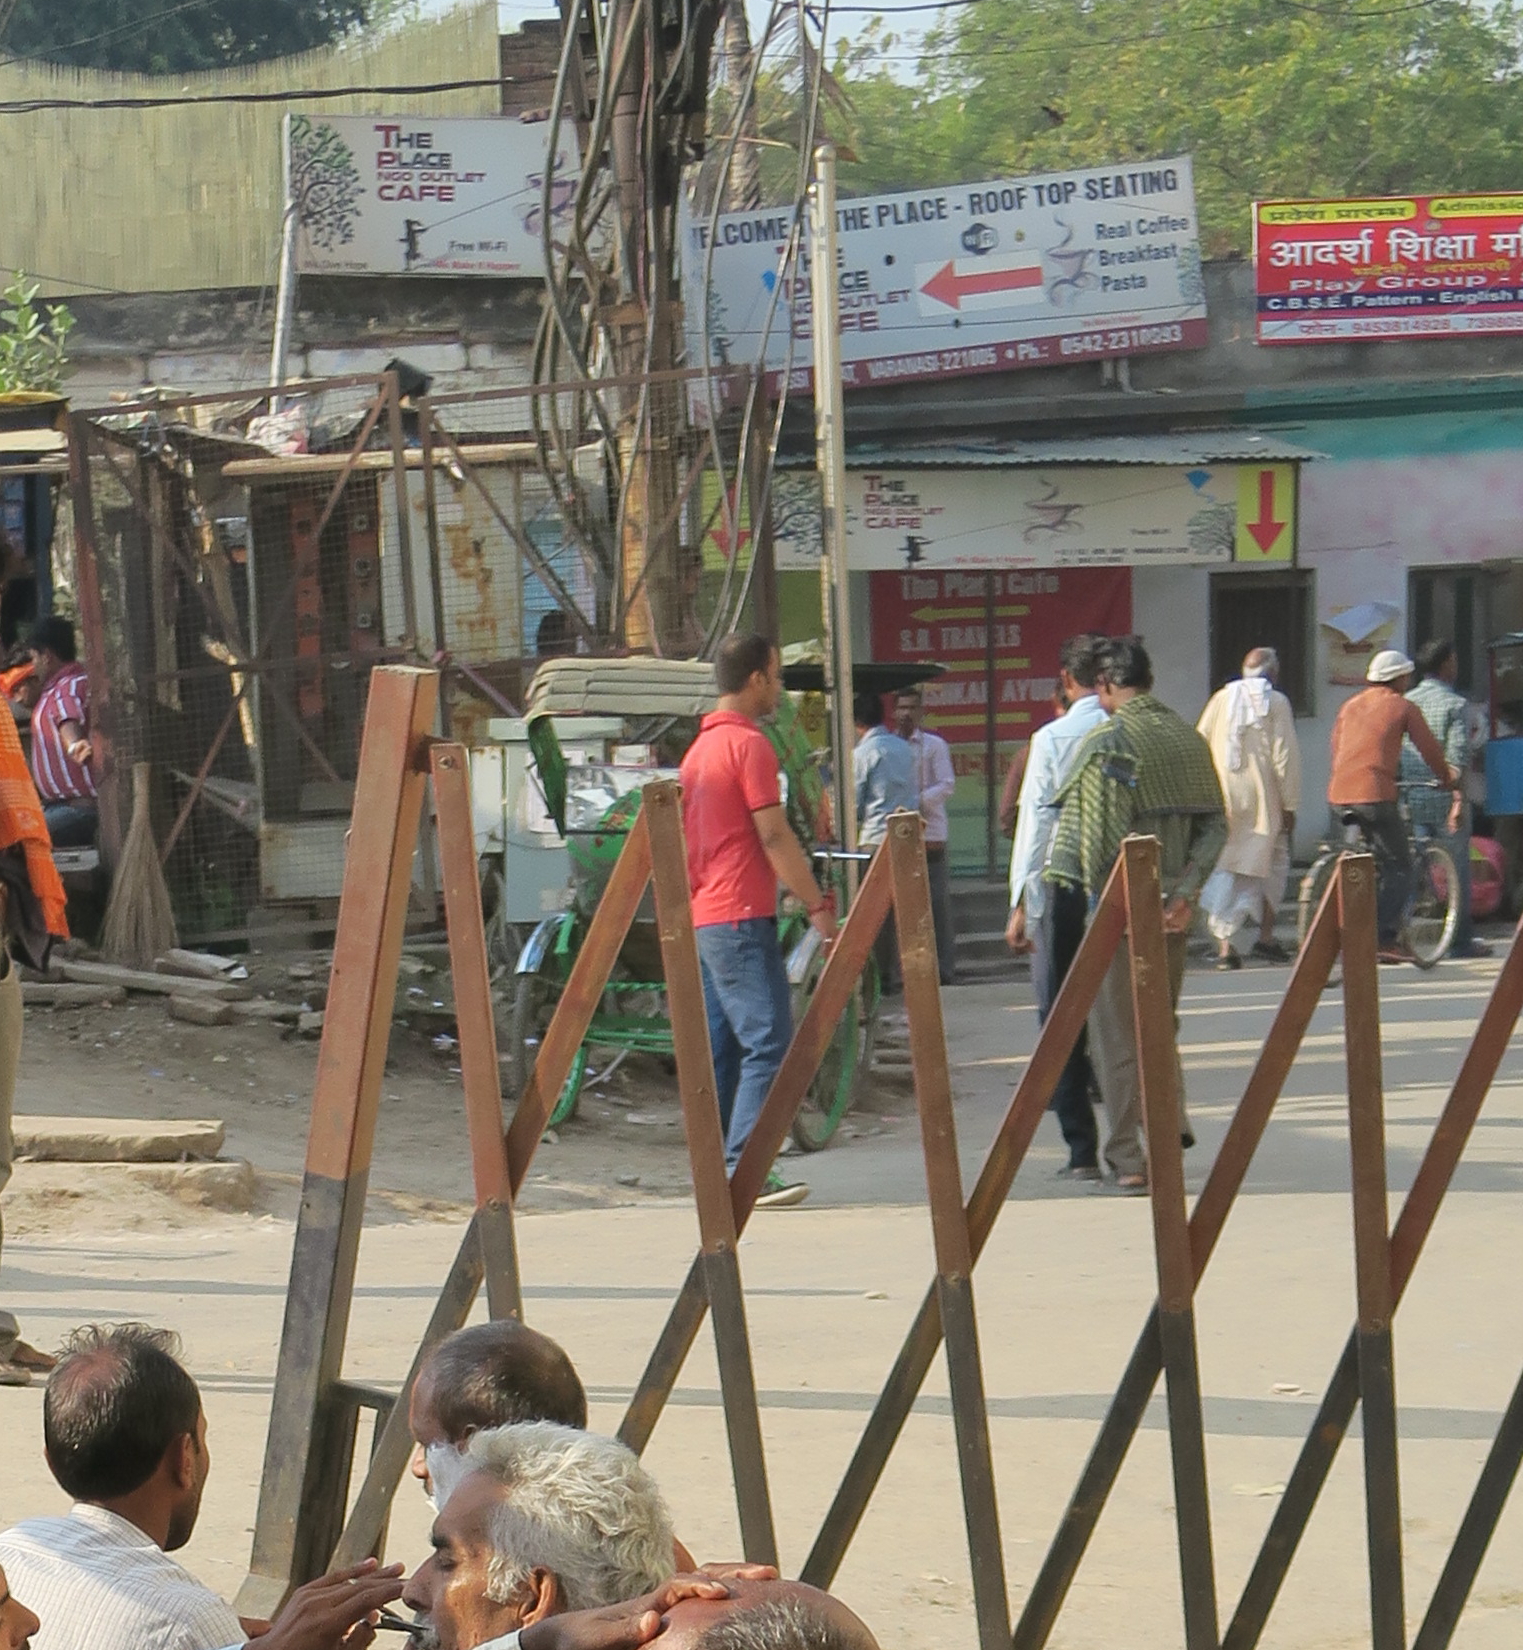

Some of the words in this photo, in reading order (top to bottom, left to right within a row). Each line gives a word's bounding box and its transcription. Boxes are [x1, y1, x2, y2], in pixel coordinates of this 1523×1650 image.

[374, 125, 433, 148] THE
[376, 152, 452, 168] PLACE
[376, 172, 413, 181] NGO
[420, 172, 486, 182] OUTLET
[377, 185, 455, 201] CAFE
[877, 197, 947, 227] PLACE
[969, 187, 1028, 215] ROOF
[1034, 181, 1076, 207] TOP
[1085, 169, 1178, 200] SEATING
[1270, 208, 1325, 221] प्रवेश
[1096, 221, 1132, 240] Real
[1136, 215, 1189, 236] Coffee
[1099, 243, 1178, 267] Breakfast
[1269, 228, 1376, 267] आदर्श
[1386, 226, 1477, 263] शिक्षा
[1101, 274, 1147, 291] Pasta
[1290, 279, 1365, 293] Play
[1376, 274, 1487, 289] Group
[1267, 296, 1347, 310] C.B.S.E.
[1351, 293, 1423, 308] Pattern
[1439, 289, 1513, 304] English
[863, 475, 905, 492] THE
[865, 494, 919, 506] PLACE
[865, 518, 922, 529] CAFE
[900, 575, 938, 600] The
[1008, 573, 1059, 594] Cafe
